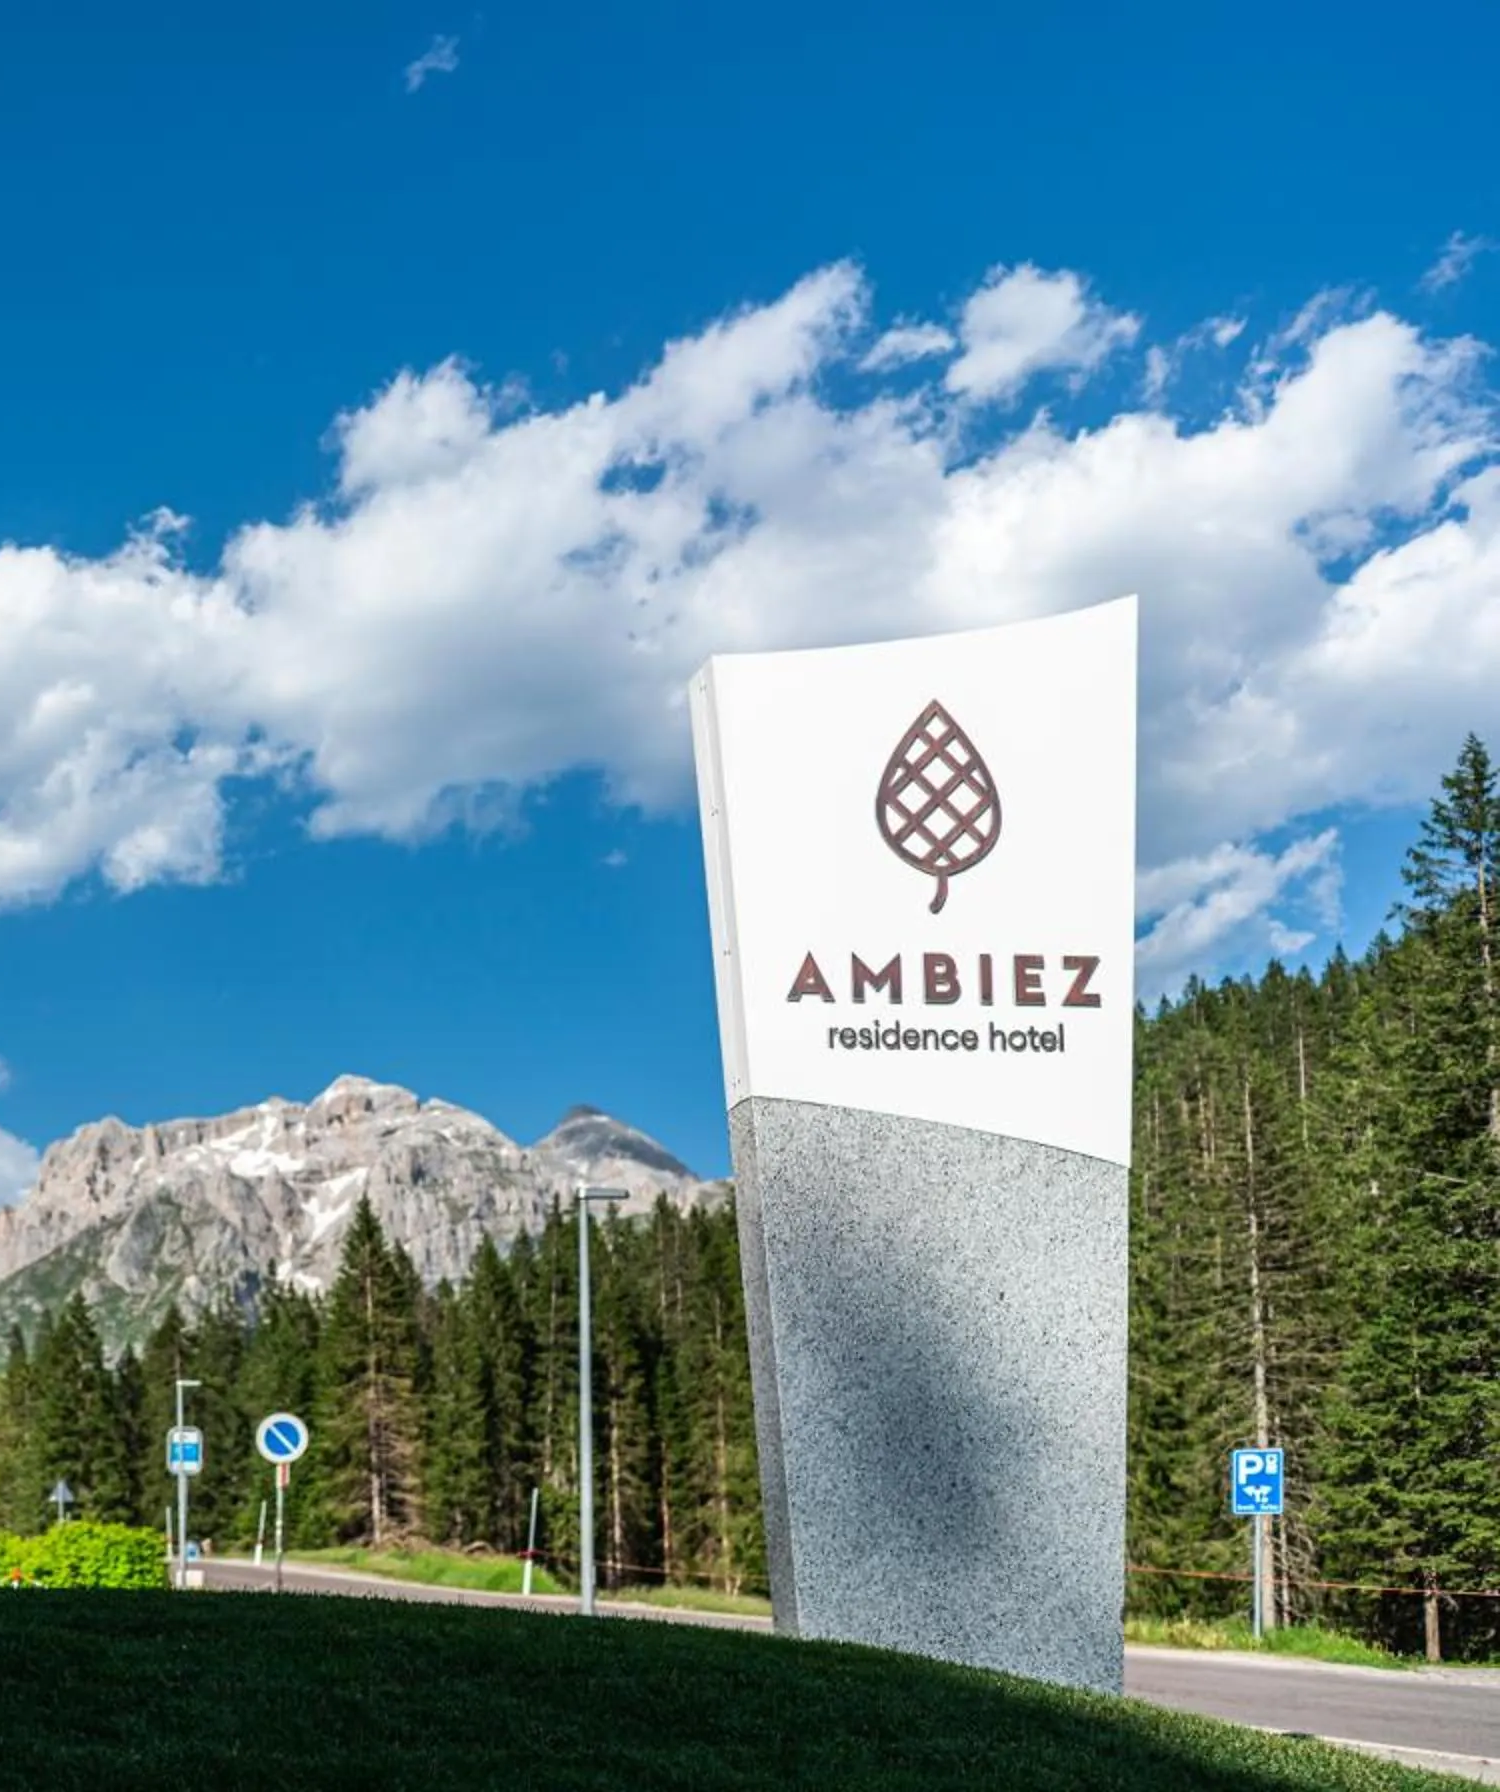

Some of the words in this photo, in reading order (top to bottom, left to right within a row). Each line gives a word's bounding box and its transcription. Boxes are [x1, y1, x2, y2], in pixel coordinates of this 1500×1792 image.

[787, 950, 1102, 1008] AMBIEZ
[828, 1020, 979, 1052] residence
[990, 1022, 1065, 1053] hotel
[1238, 1453, 1264, 1485] P
